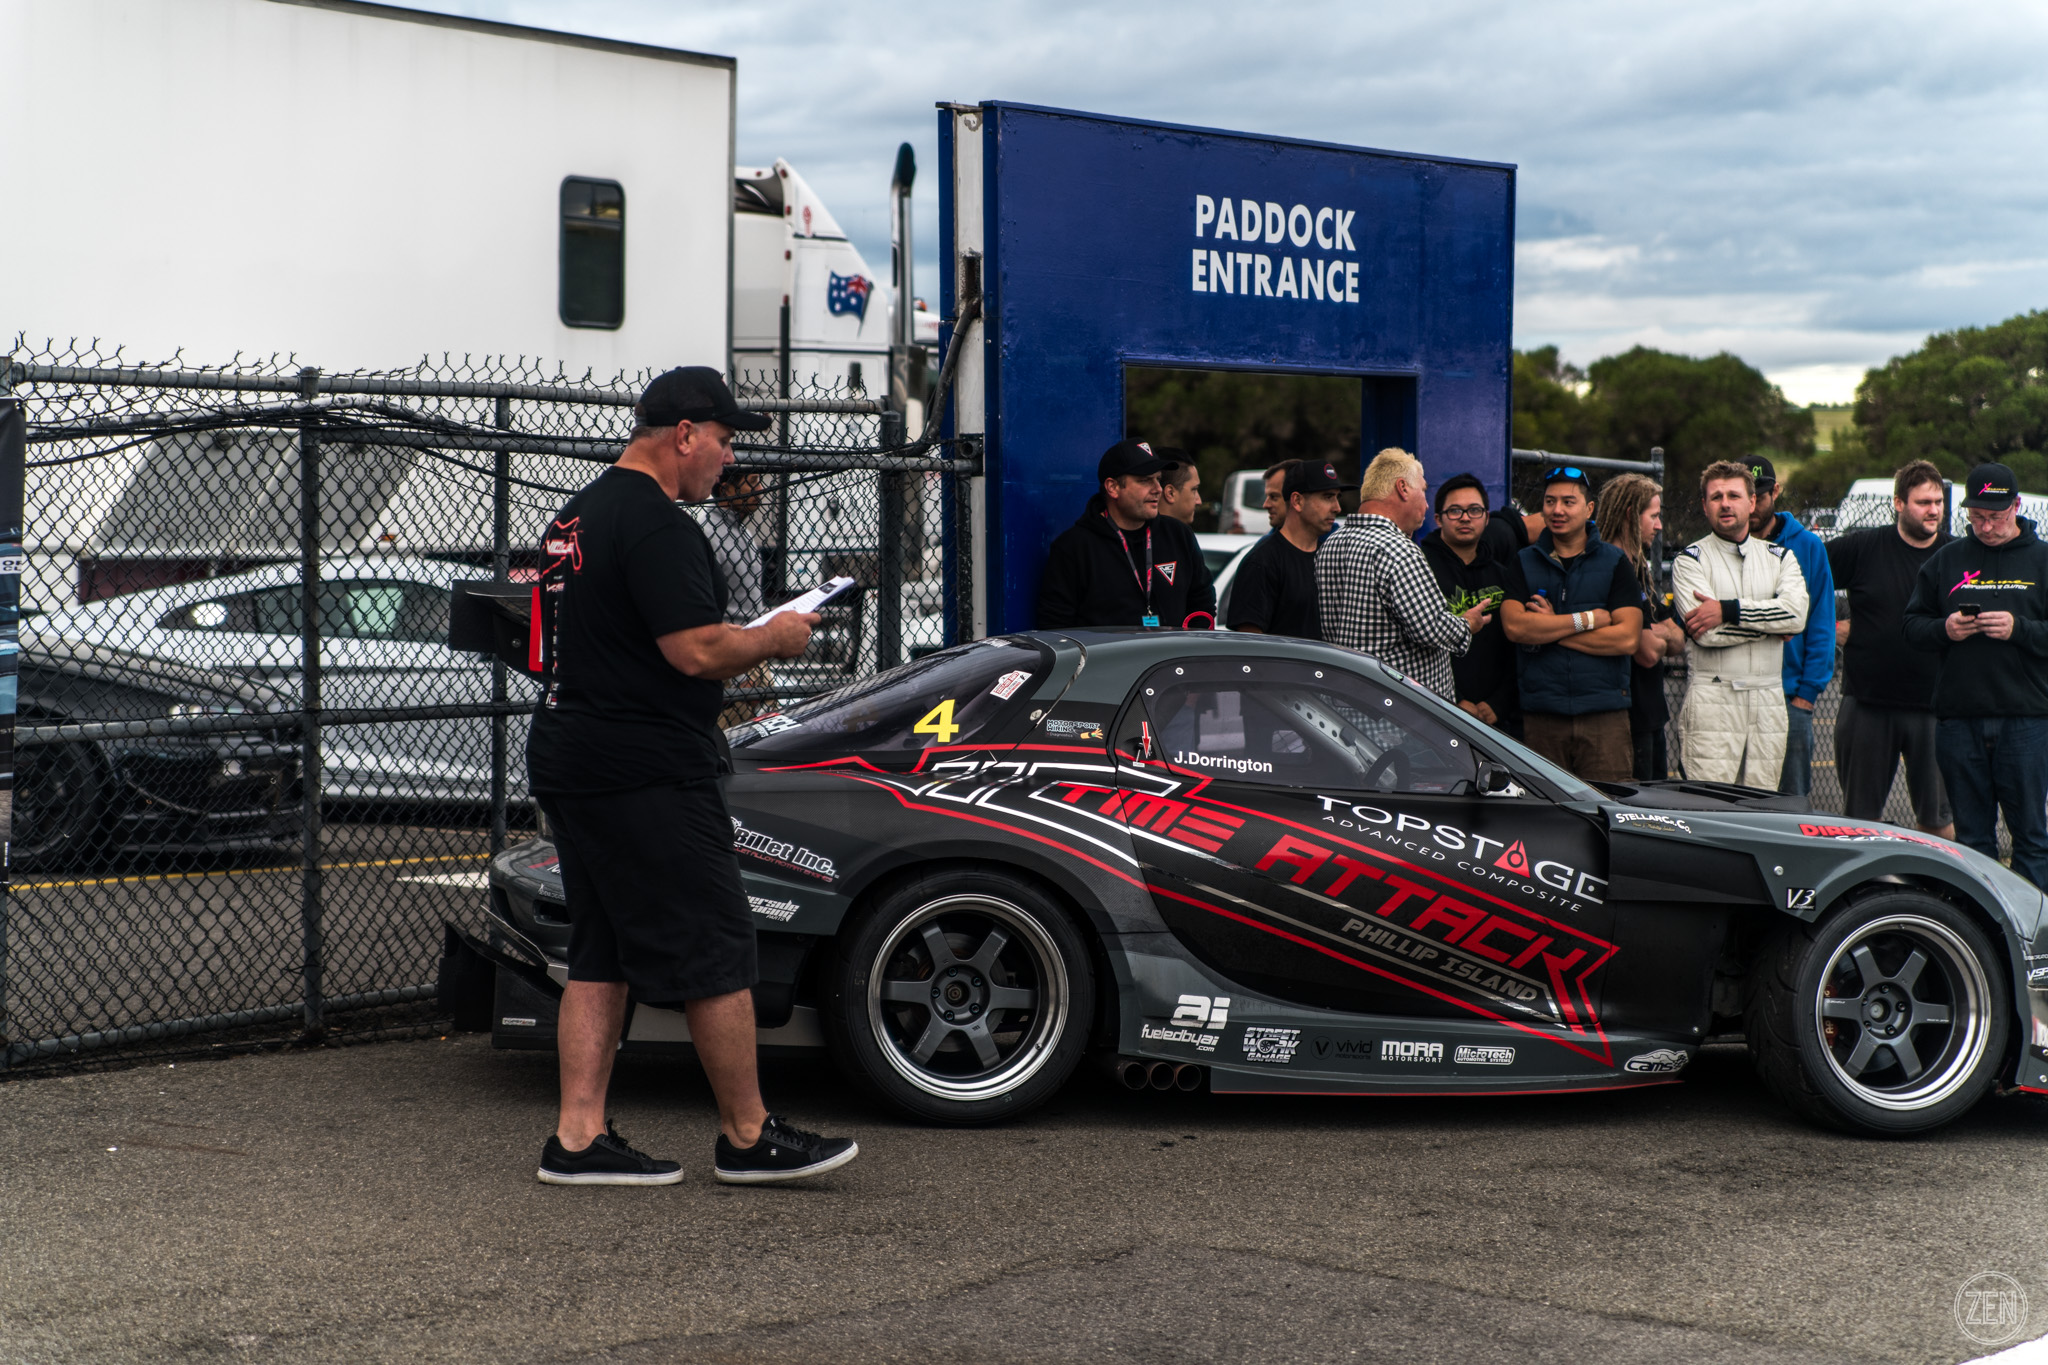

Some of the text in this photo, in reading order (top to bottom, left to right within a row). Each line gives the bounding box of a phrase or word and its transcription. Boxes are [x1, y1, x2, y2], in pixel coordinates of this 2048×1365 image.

[1196, 194, 1356, 251] PADDOCK
[1192, 249, 1359, 303] ENTRANCE
[913, 699, 959, 742] 4
[1046, 719, 1101, 730] MOTORSPORT
[1173, 750, 1273, 773] J.Dorrington
[1799, 824, 1880, 836] DIRECT
[734, 827, 837, 877] Billet Inc.
[1322, 815, 1582, 912] ADVANCED COMPOSITE
[1787, 888, 1816, 909] V3
[1057, 782, 1588, 1037] TIME ATTACK
[1341, 918, 1538, 1002] PHILLIP ISLAND
[1170, 994, 1231, 1030] ai
[1141, 1024, 1220, 1046] fueledbyai
[1245, 1026, 1301, 1040] STREET
[1242, 1037, 1300, 1055] WORK
[1336, 1039, 1373, 1054] vivid
[1382, 1041, 1443, 1057] MORA
[1458, 1047, 1513, 1059] MicroTech
[1246, 1052, 1291, 1063] GARAGE
[1381, 1055, 1443, 1063] MOTORSPORT
